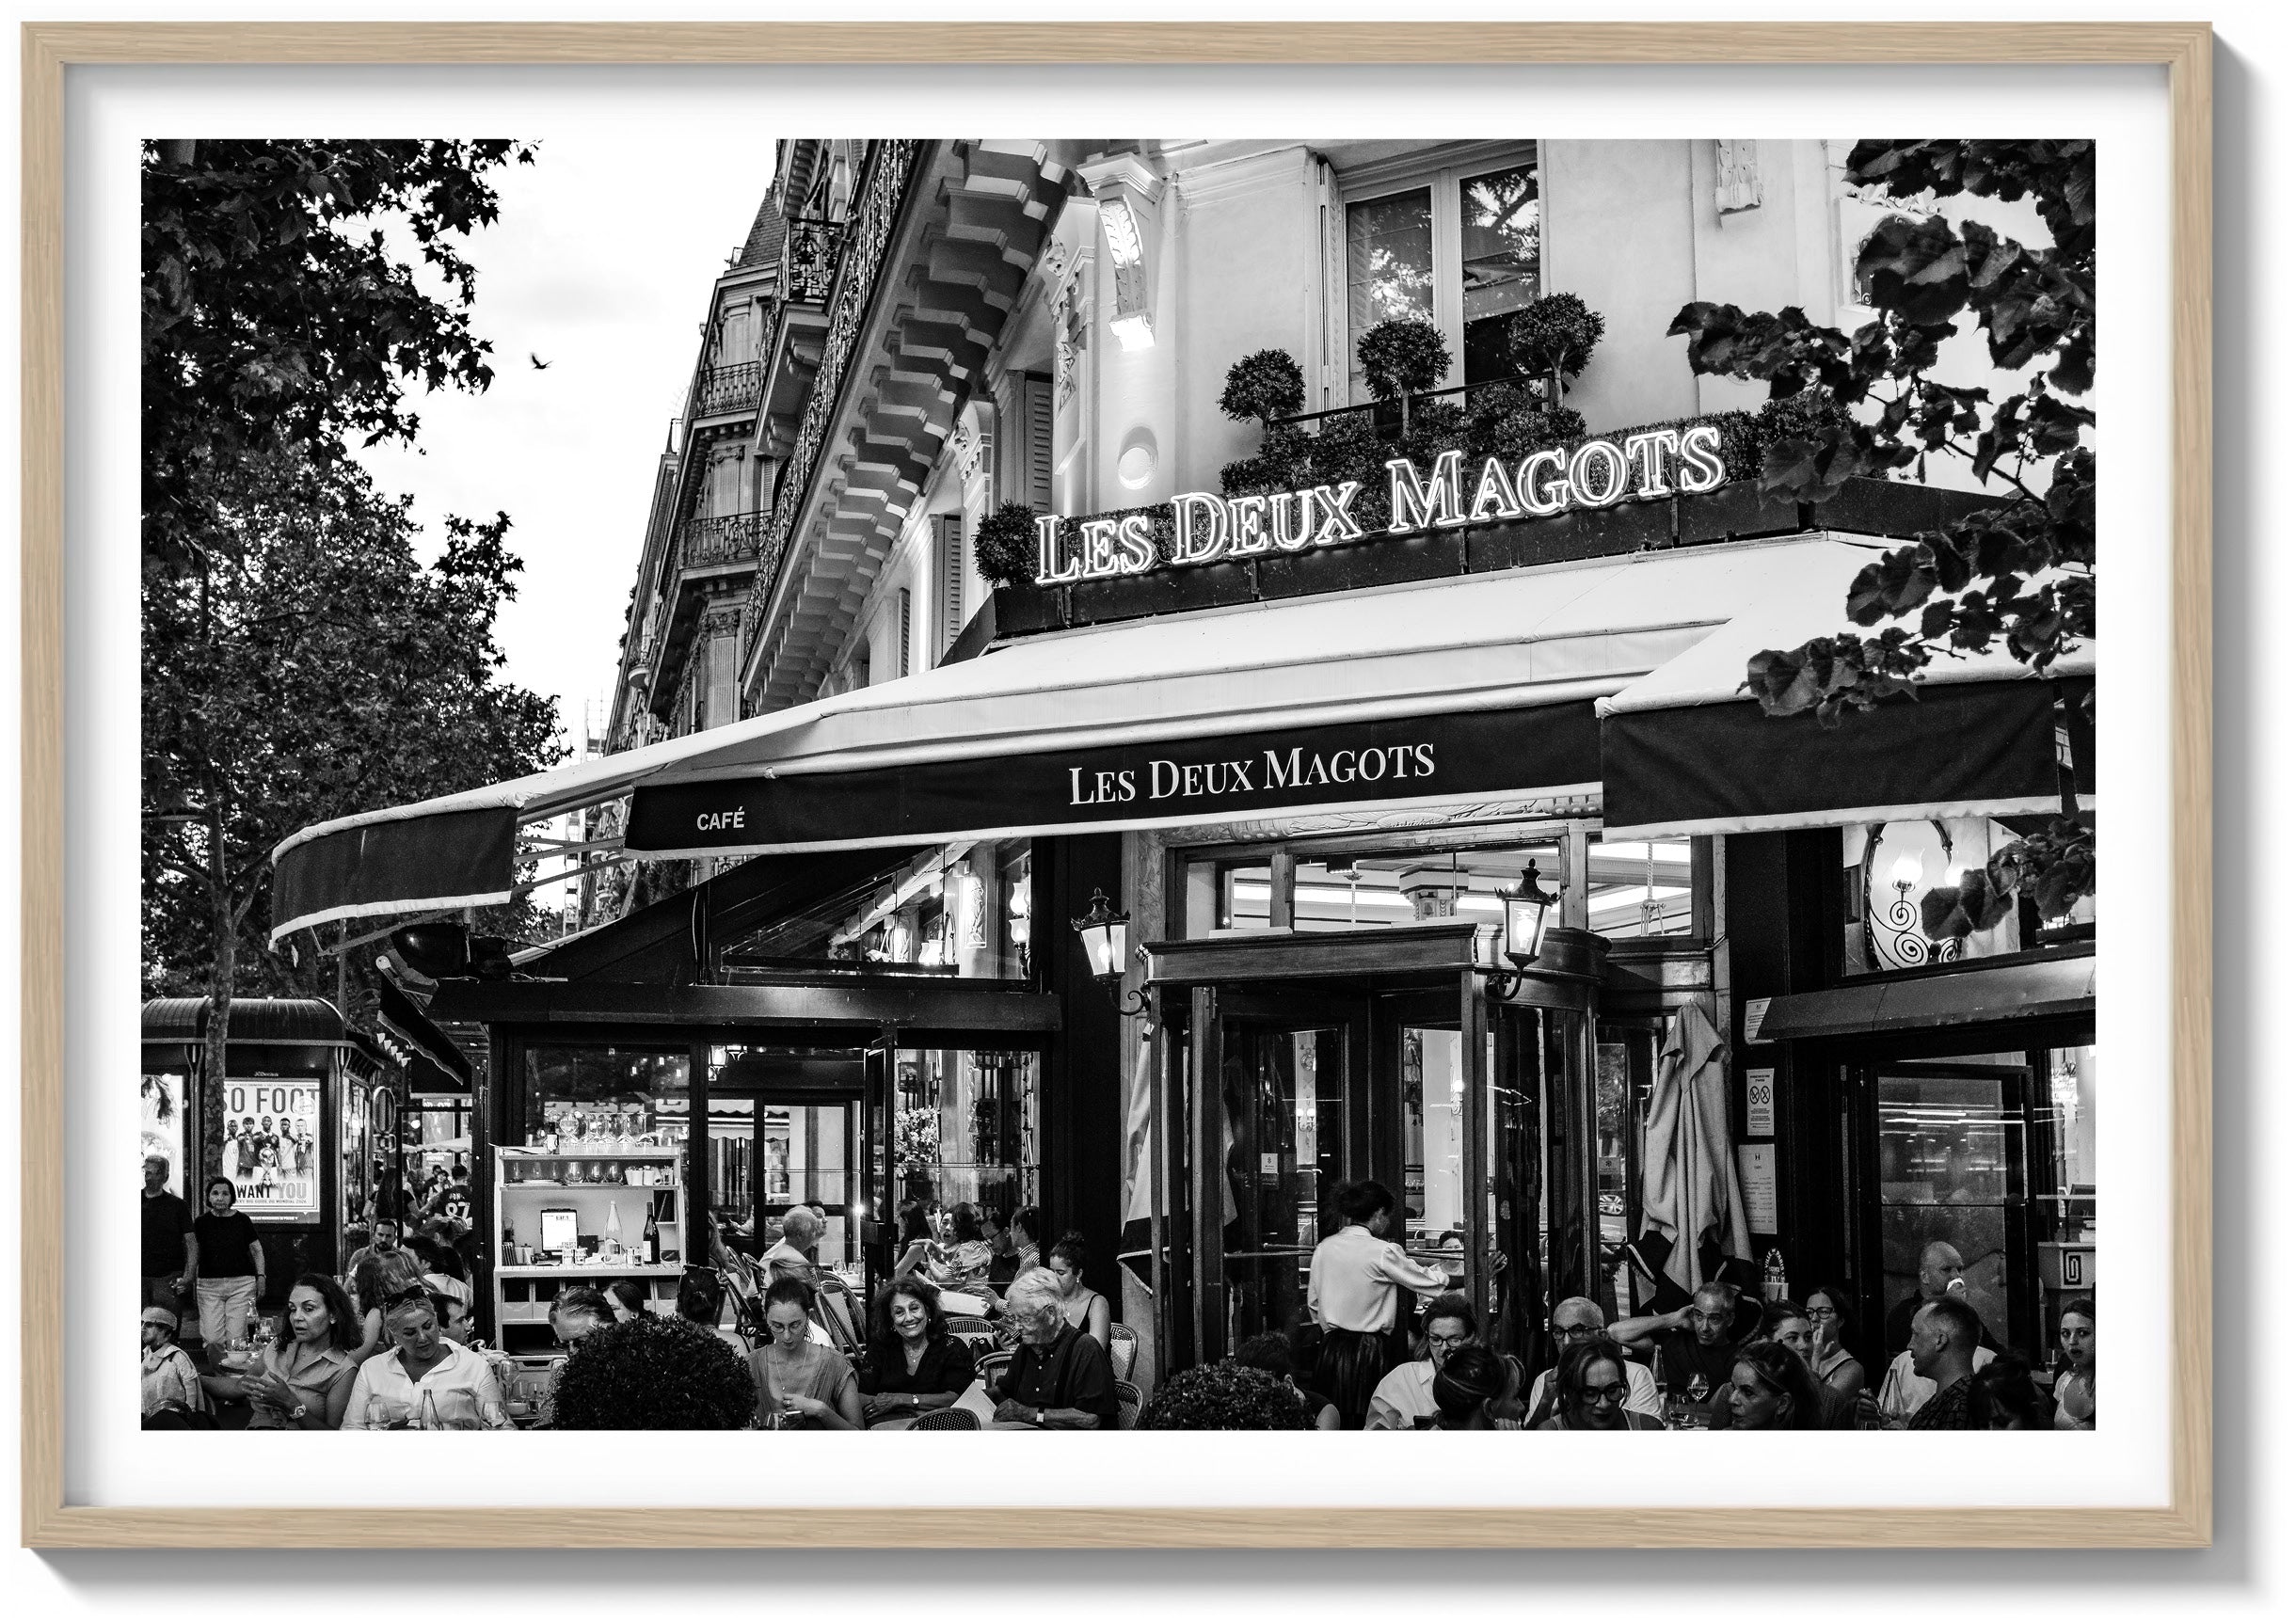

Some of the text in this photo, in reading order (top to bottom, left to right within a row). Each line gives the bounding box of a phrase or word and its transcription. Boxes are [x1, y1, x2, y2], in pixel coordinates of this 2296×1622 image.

[697, 805, 745, 831] CAFÉ
[236, 1182, 307, 1200] WANT YOU
